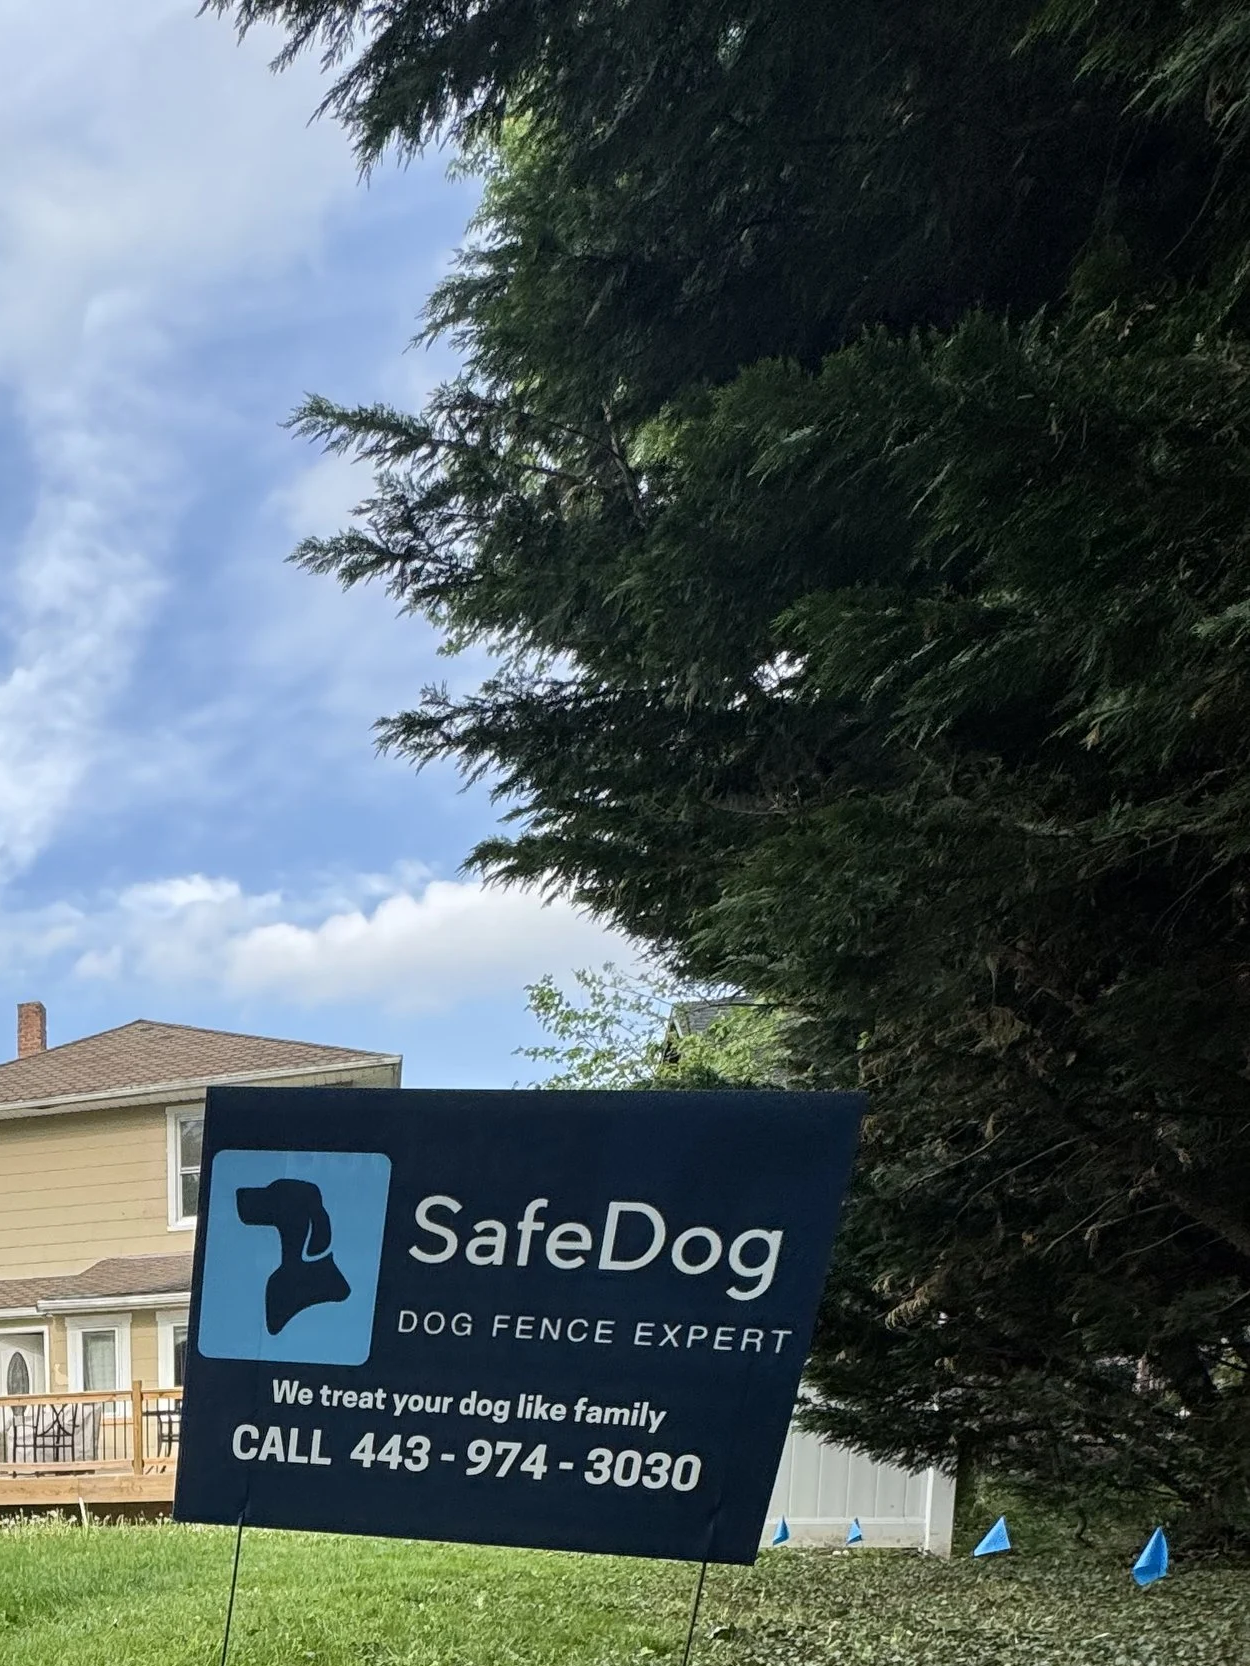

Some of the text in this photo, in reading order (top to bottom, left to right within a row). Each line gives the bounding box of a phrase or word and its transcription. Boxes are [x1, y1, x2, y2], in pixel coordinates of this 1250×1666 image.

[408, 1193, 785, 1303] SafeDog
[397, 1310, 794, 1355] DOG FENCE EXPERT
[272, 1379, 667, 1434] We treat your dog like family
[232, 1423, 333, 1467] CALL
